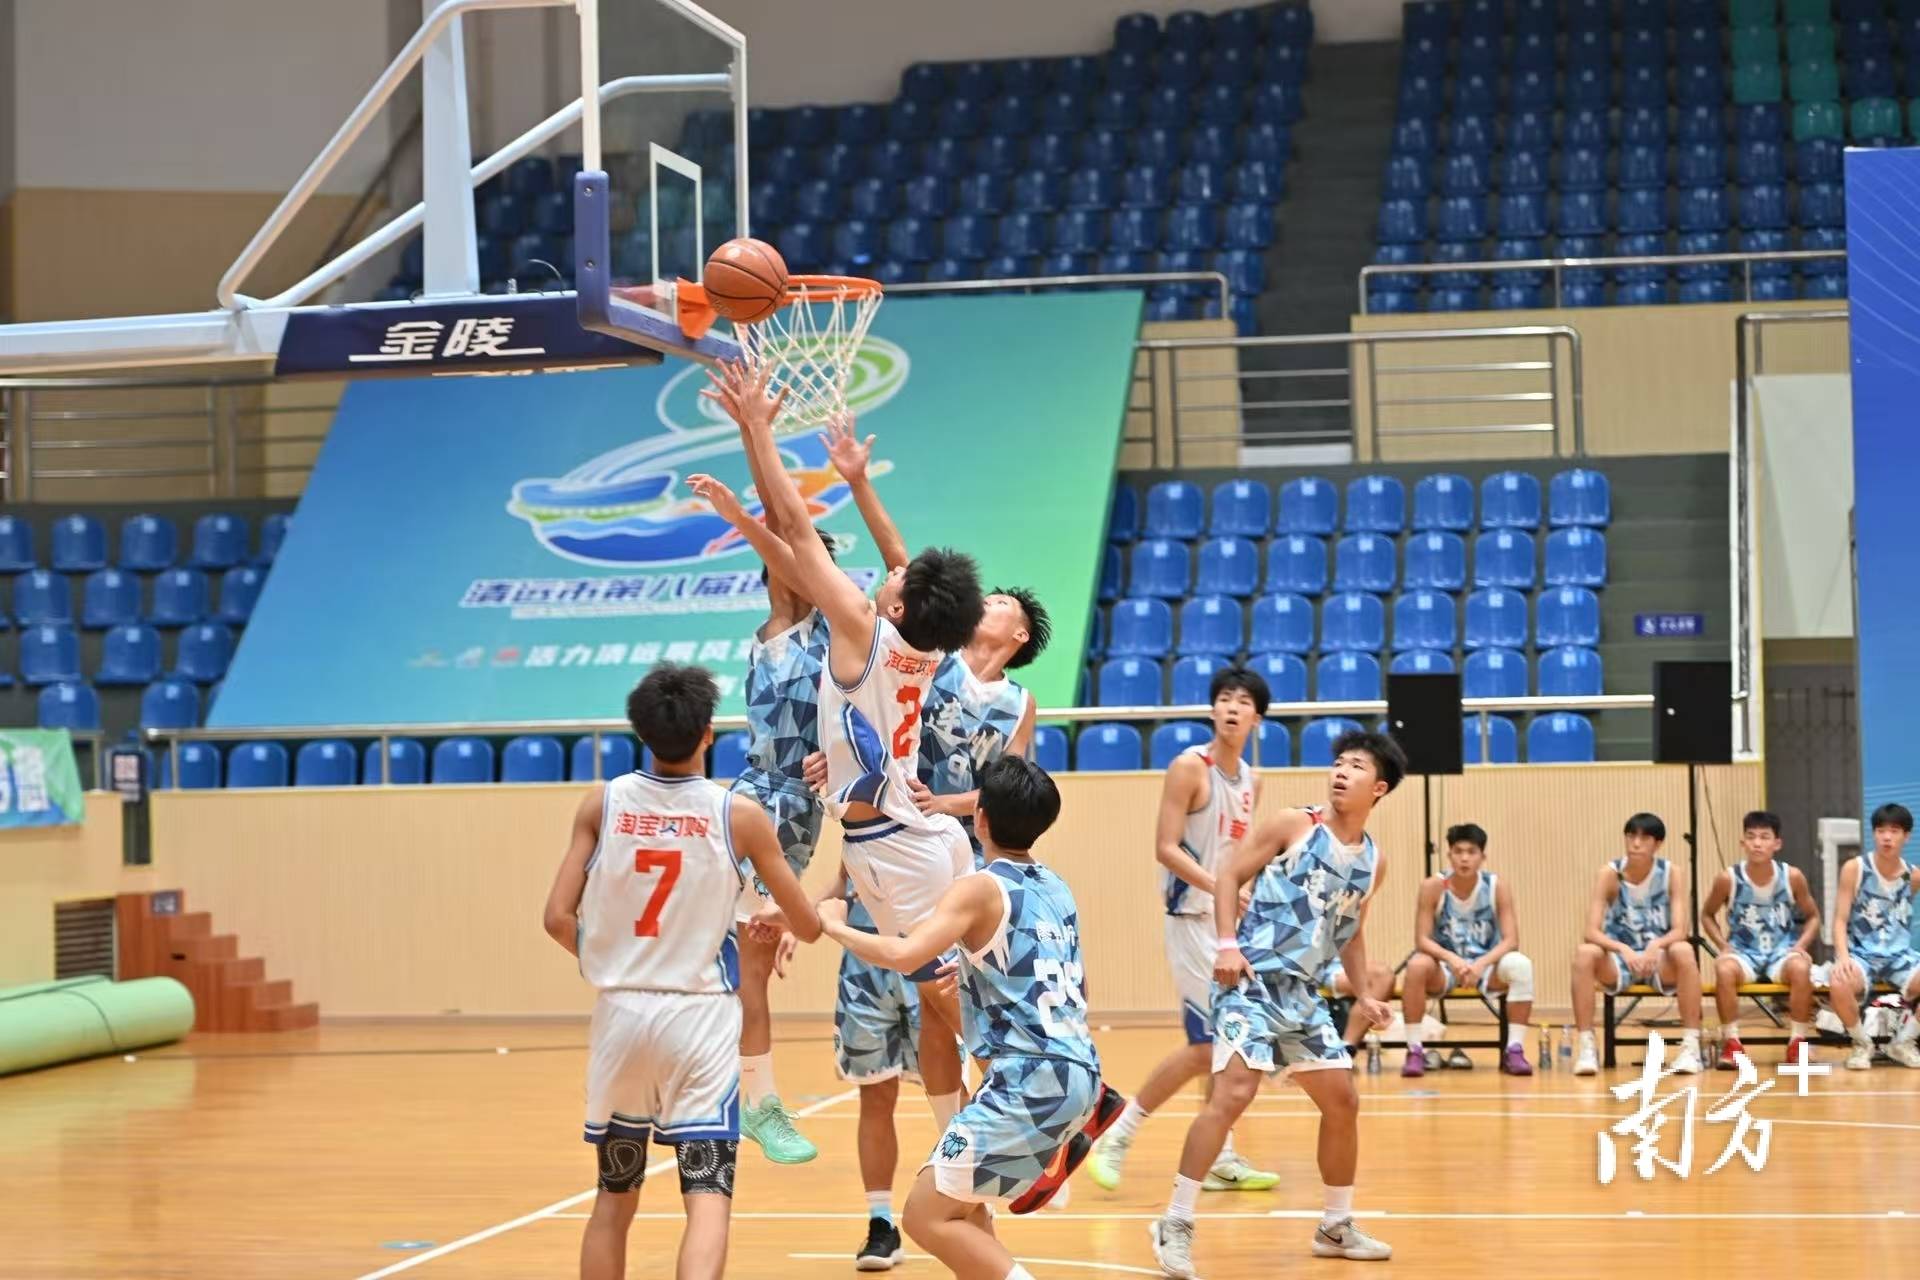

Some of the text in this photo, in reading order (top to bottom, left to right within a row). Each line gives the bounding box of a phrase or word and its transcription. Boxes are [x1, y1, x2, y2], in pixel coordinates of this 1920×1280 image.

[348, 317, 546, 362] 金陵
[891, 684, 922, 760] 2
[614, 812, 709, 838] 淘宝闪购
[633, 848, 682, 937] 7
